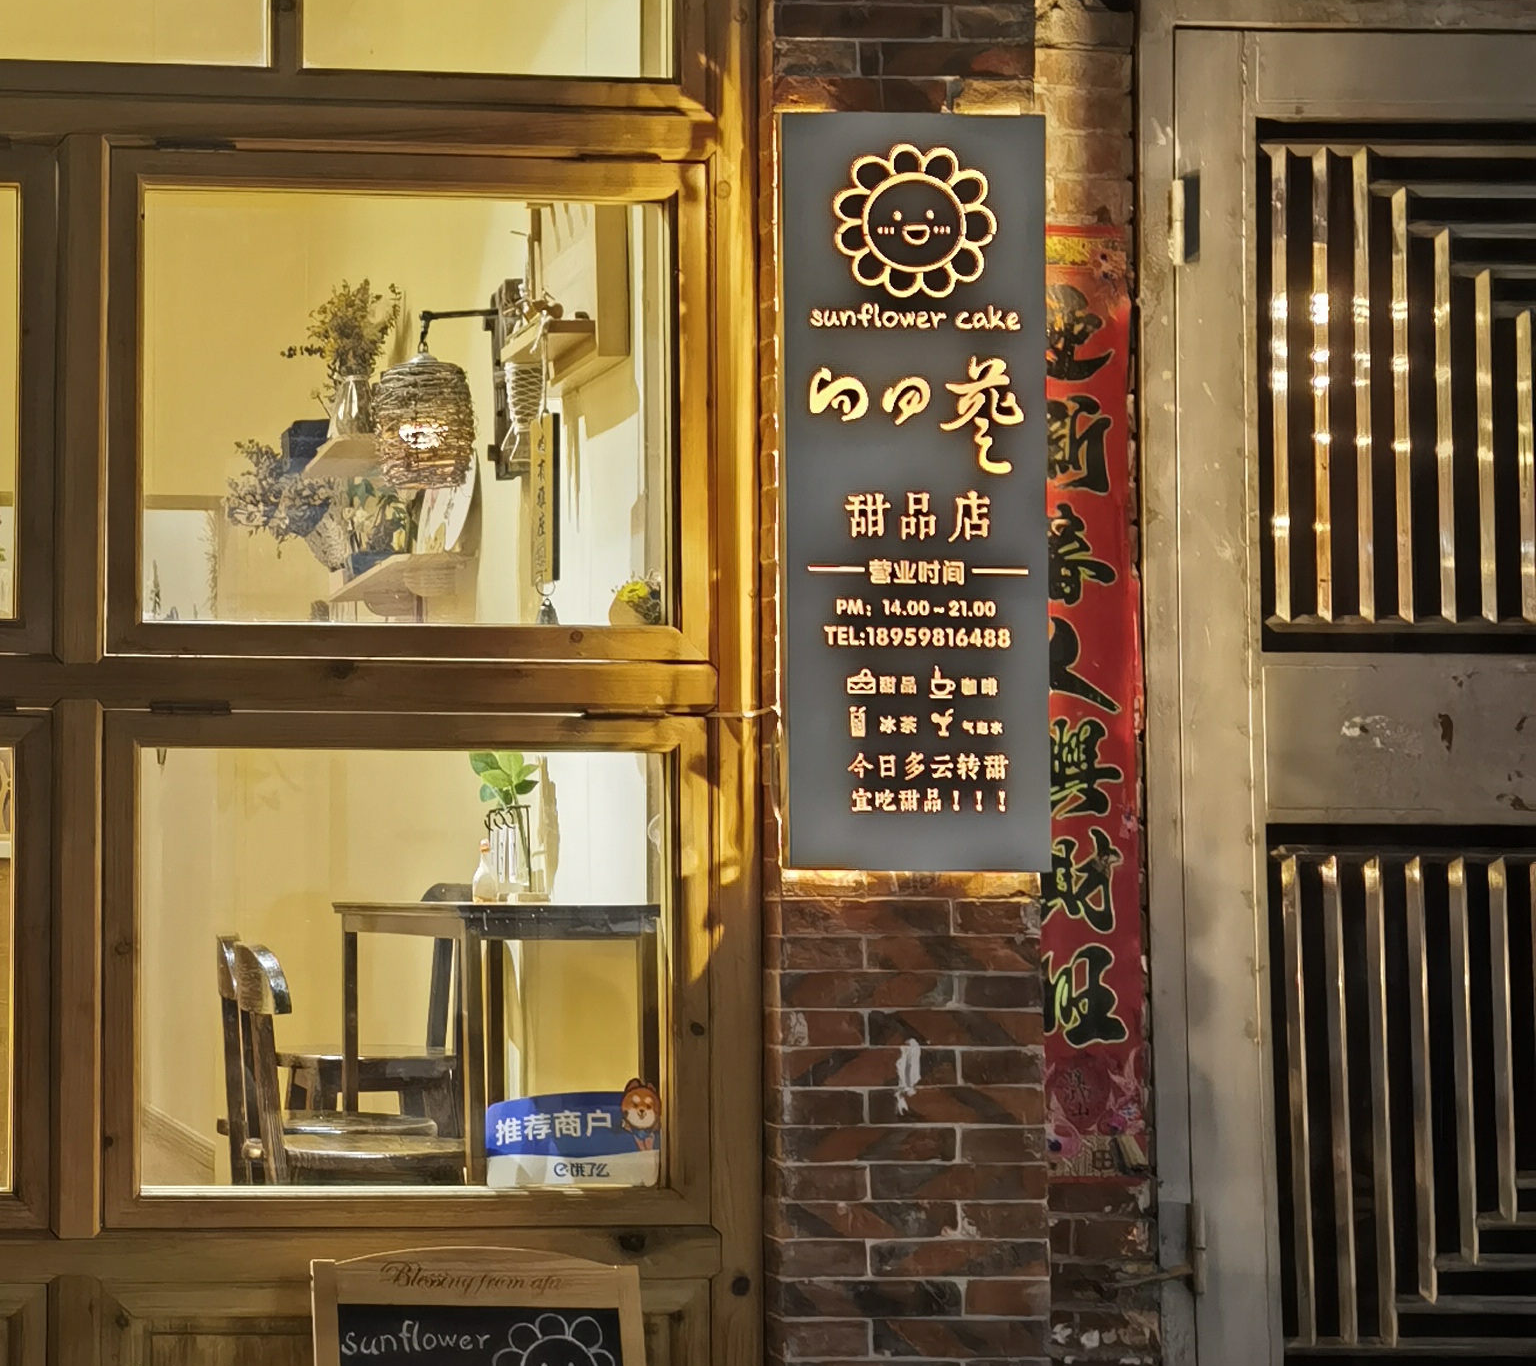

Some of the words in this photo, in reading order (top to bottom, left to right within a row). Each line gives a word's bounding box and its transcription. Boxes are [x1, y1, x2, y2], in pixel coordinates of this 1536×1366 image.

[809, 302, 946, 330] sunflower
[955, 305, 1021, 332] cake
[809, 355, 1025, 475] 向日葵
[845, 491, 991, 542] 甜品店
[868, 559, 965, 586] 营业时间
[823, 625, 1012, 649] TEL:18959816488
[879, 675, 917, 695] 甜品
[879, 715, 918, 734] 冰茶
[847, 751, 1009, 781] 今日多云转甜
[495, 1109, 612, 1146] 推荐商户
[341, 1320, 490, 1356] sunflower
